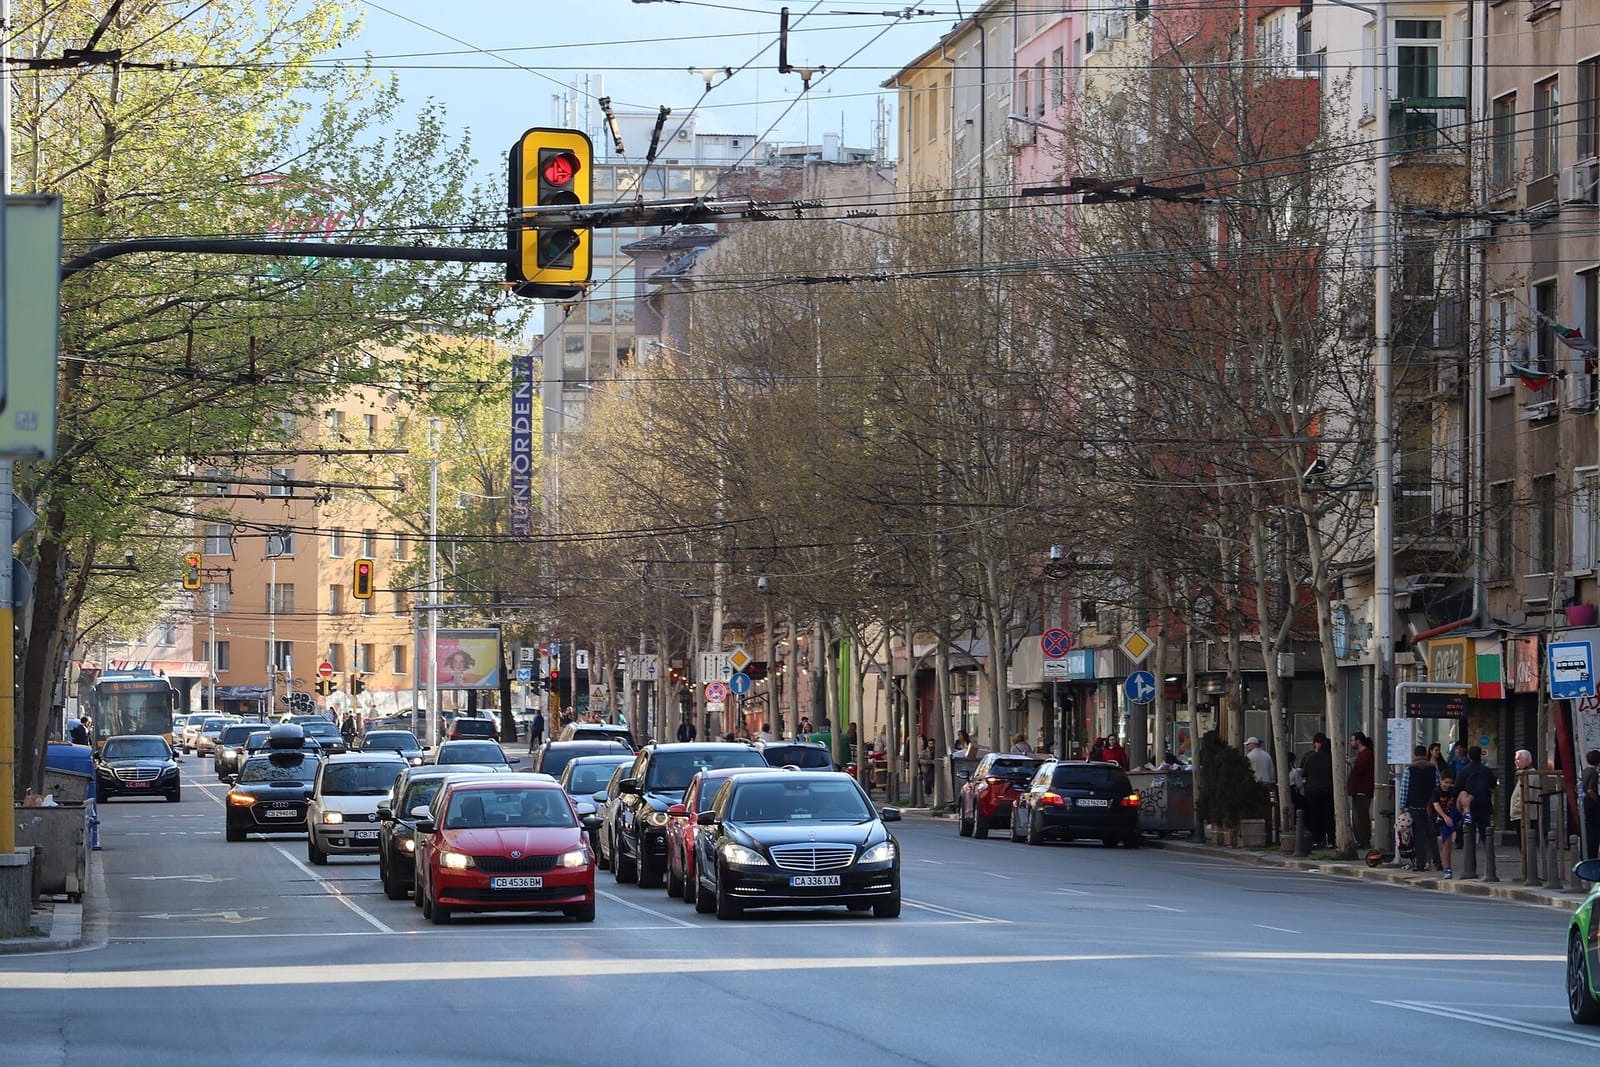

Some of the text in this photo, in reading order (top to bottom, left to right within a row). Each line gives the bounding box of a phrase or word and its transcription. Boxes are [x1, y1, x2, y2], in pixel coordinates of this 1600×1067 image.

[496, 878, 507, 887] CB
[508, 878, 529, 887] 4536
[794, 876, 839, 886] CA 3361 XA
